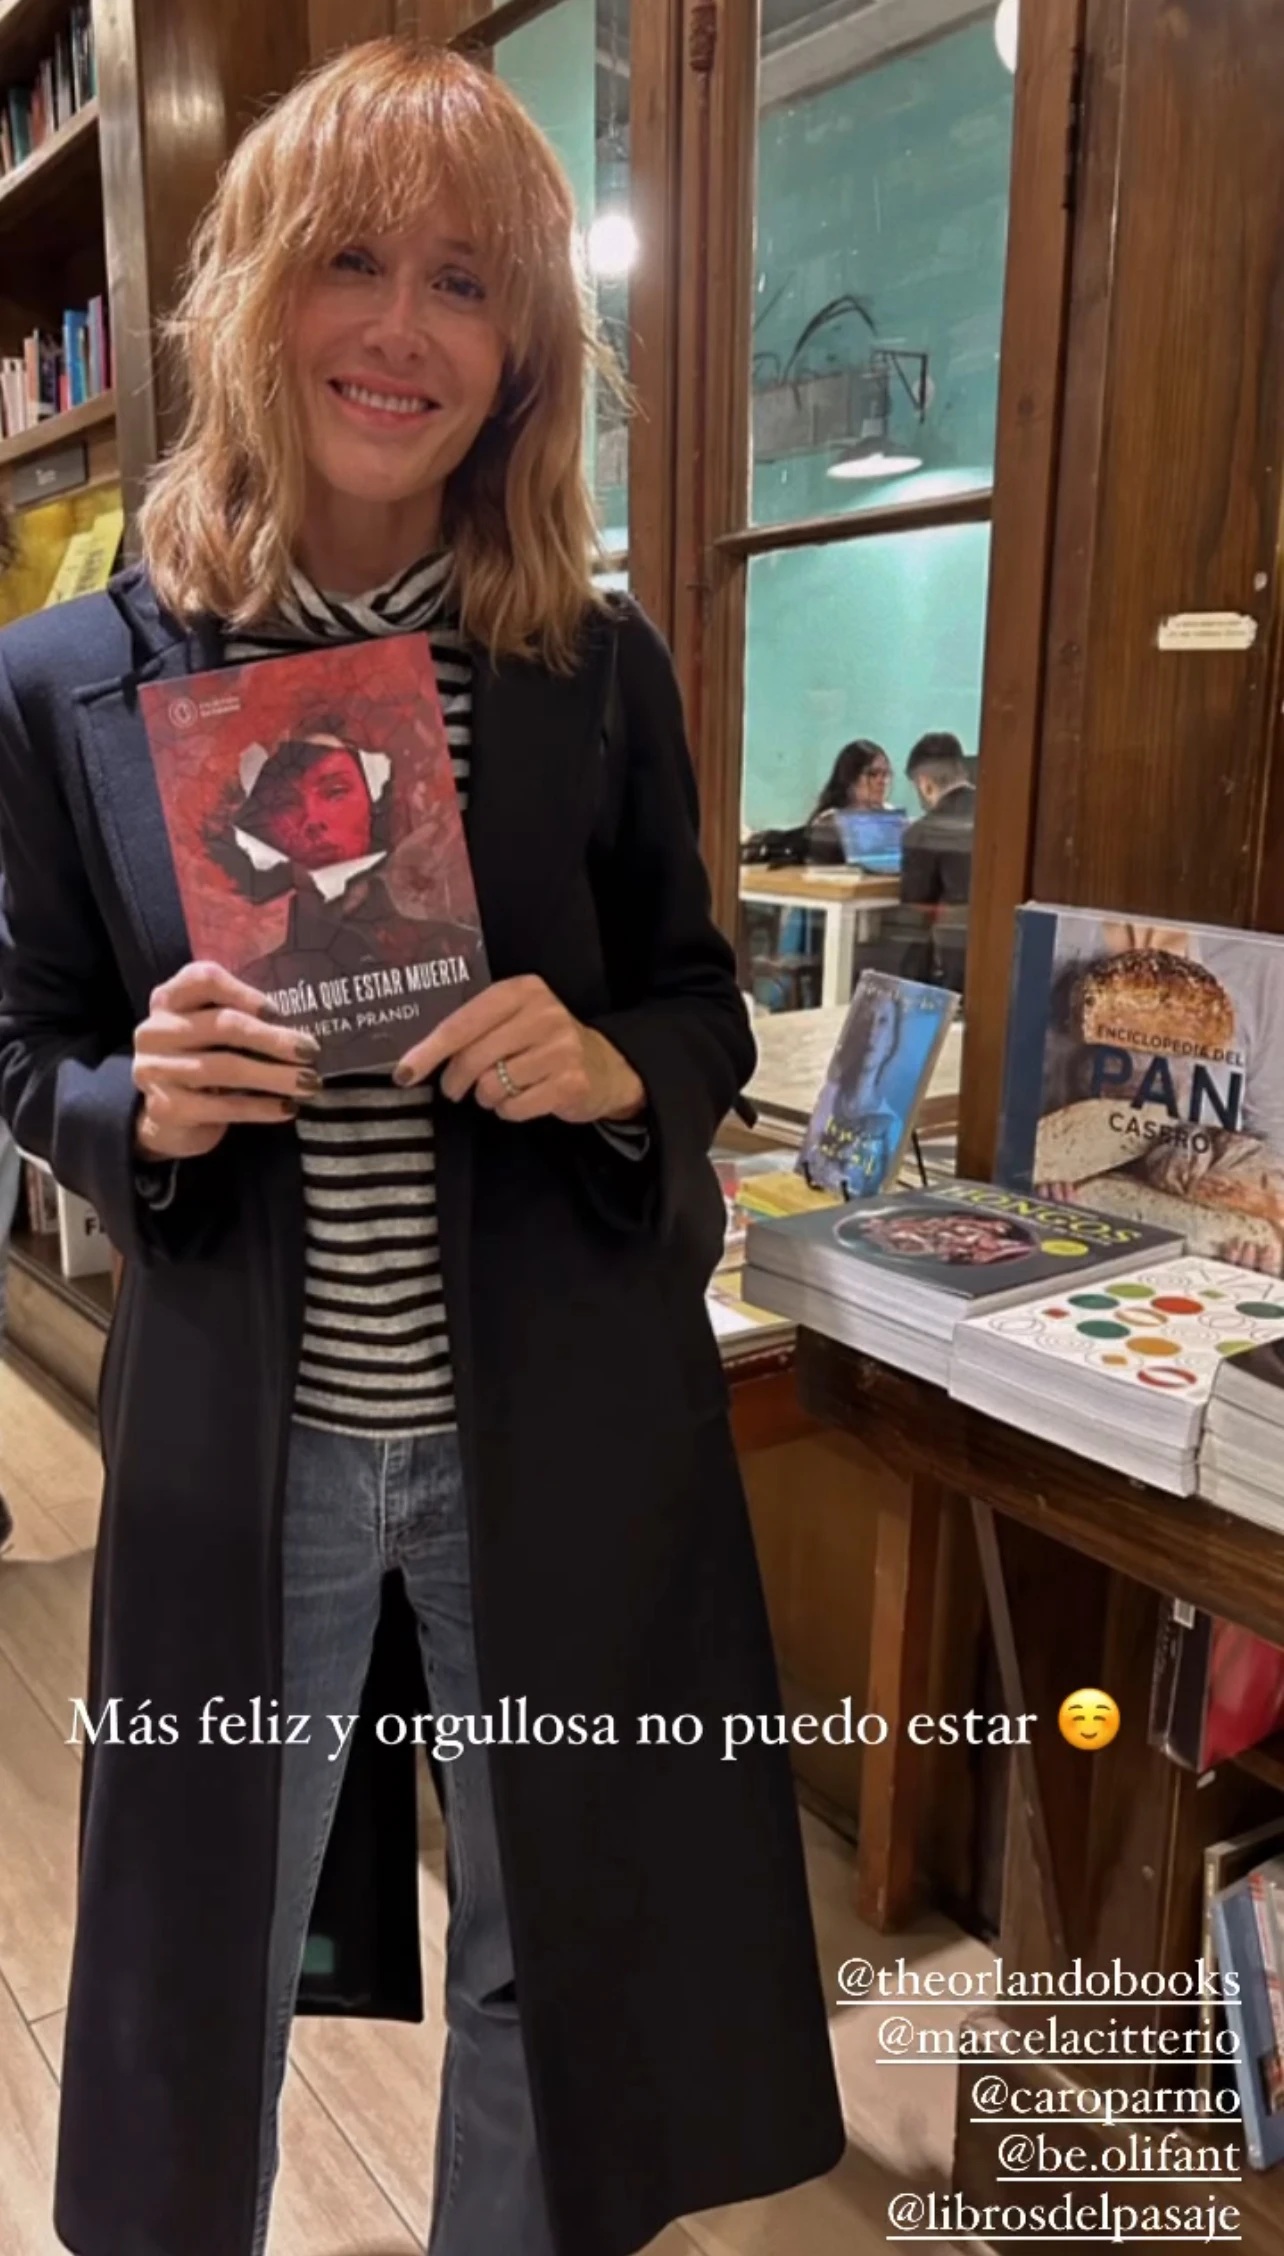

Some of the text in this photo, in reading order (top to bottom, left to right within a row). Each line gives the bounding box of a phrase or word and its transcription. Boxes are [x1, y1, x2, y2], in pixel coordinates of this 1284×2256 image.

[265, 955, 470, 1016] NDRÍA QUE ESTAR MUERTA
[356, 1003, 420, 1029] PRANDI
[1097, 1024, 1244, 1066] ENCICLOPEDIA DEL
[1091, 1044, 1243, 1132] PAN
[1108, 1111, 1210, 1154] CASERO
